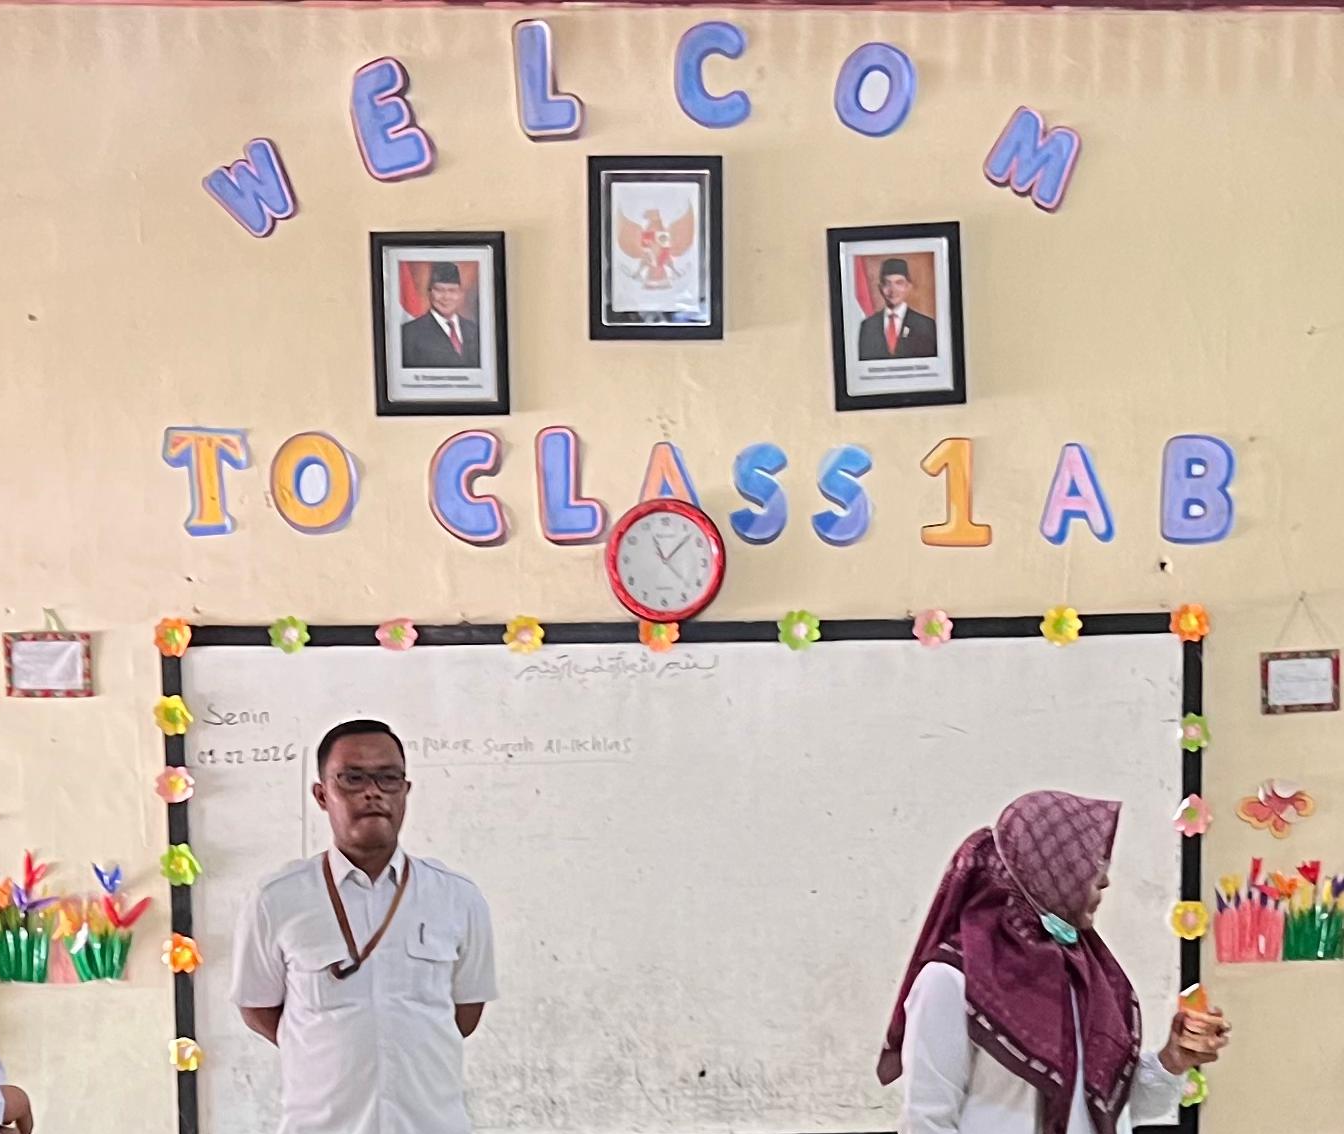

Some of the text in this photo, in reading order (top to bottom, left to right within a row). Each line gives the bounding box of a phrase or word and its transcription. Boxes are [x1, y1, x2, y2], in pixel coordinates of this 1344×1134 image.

[202, 18, 1082, 237] WELCOM
[162, 426, 356, 536] TO
[428, 426, 873, 547] CLASS
[203, 703, 270, 726] Senin
